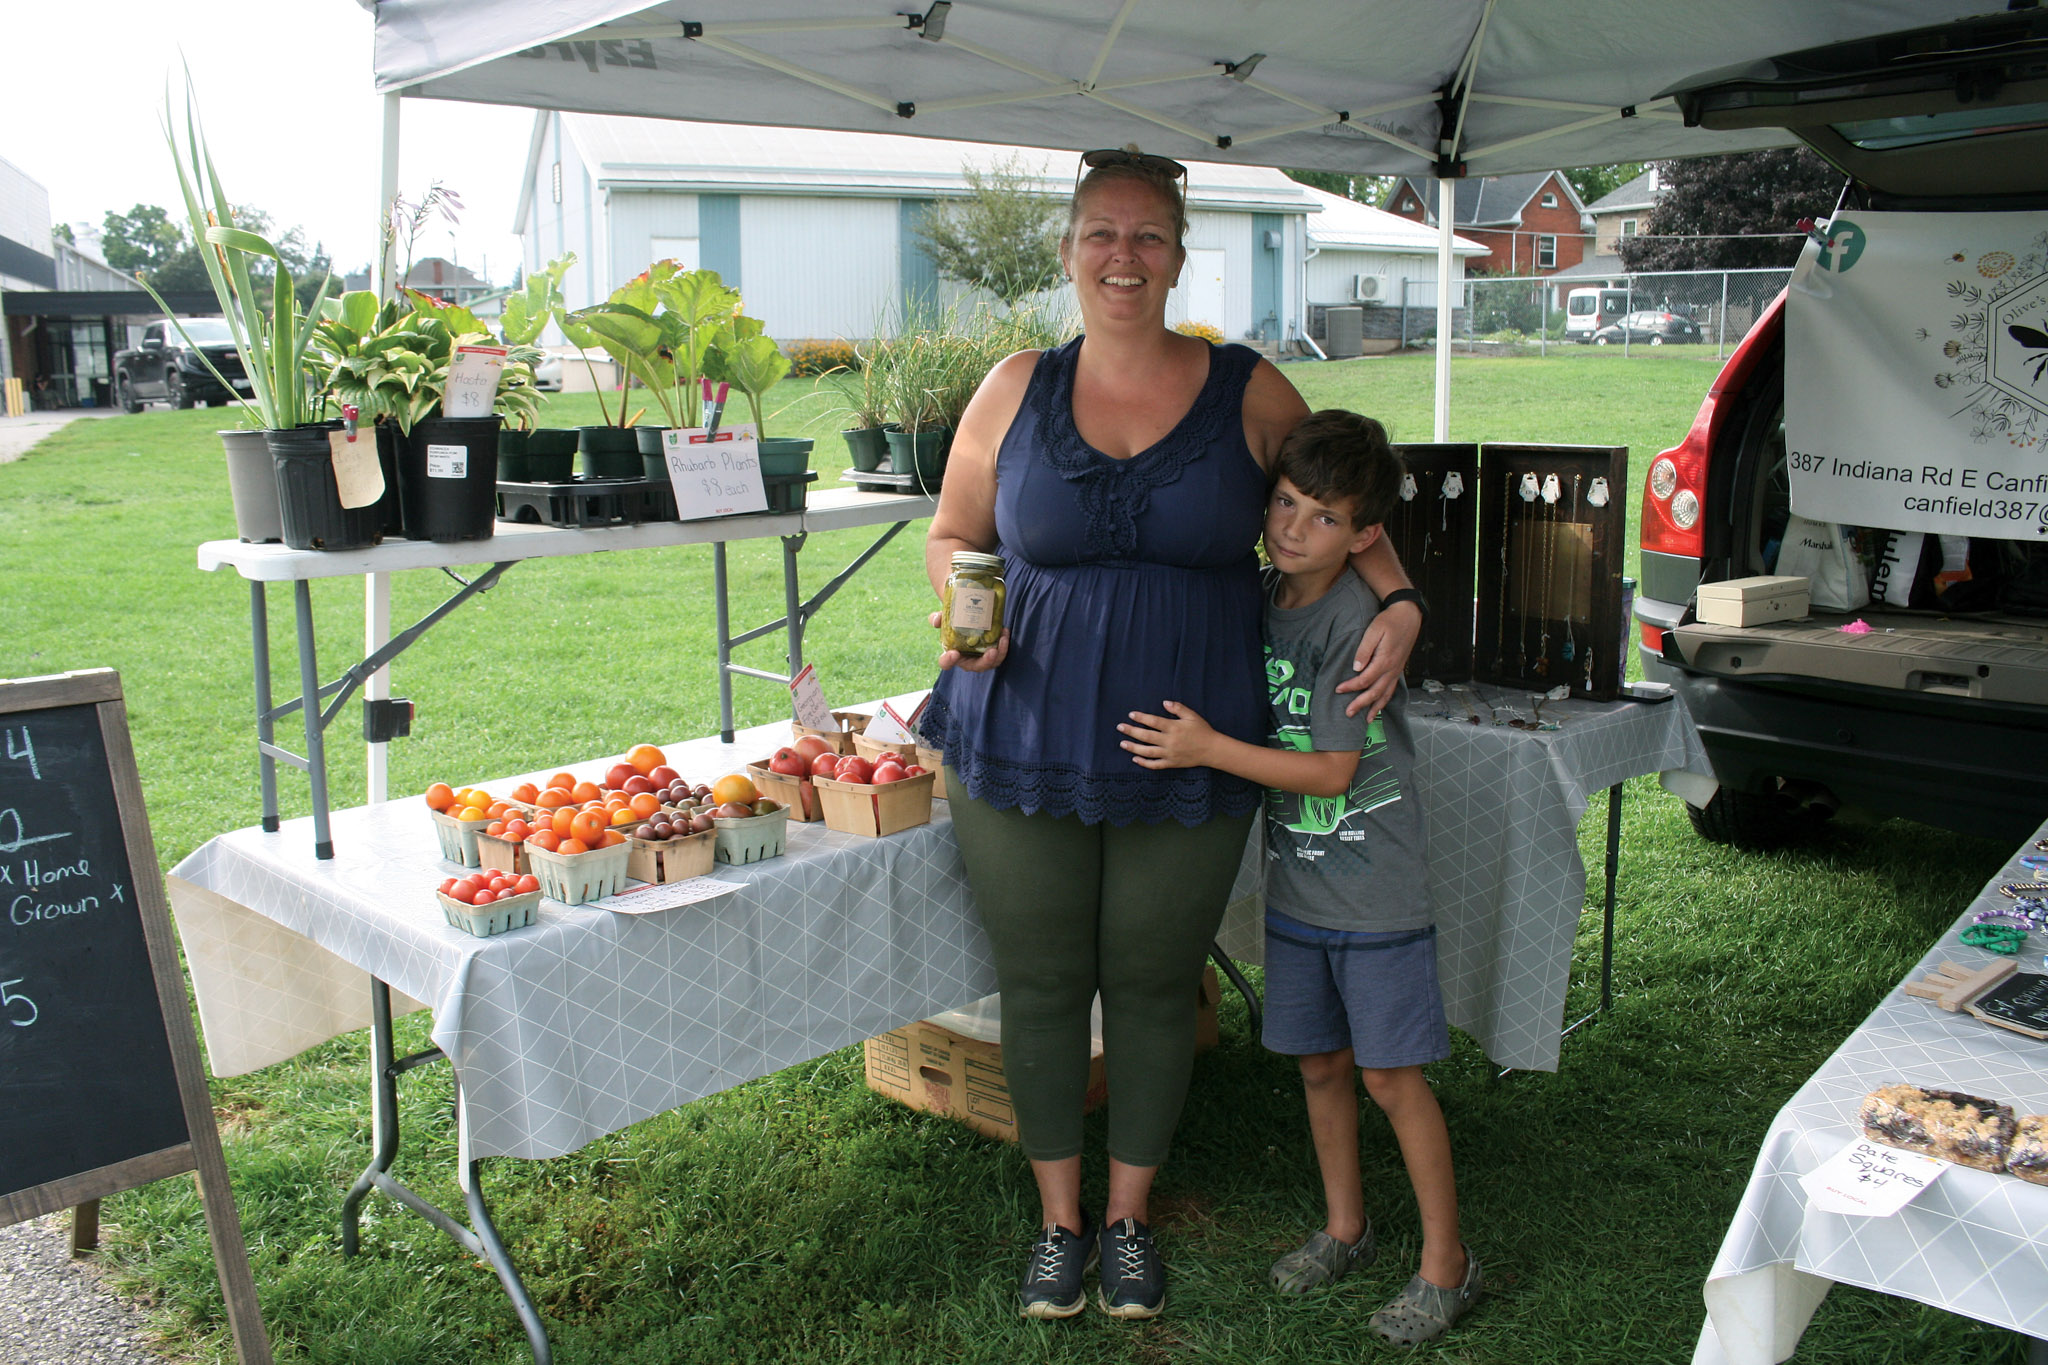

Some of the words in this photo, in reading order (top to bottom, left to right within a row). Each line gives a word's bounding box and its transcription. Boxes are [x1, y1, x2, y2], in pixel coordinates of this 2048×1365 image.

[462, 391, 480, 408] $8
[670, 455, 717, 474] Rhubarb
[720, 451, 758, 471] Plants
[1790, 451, 1825, 473] 387
[1832, 458, 1913, 483] Indiana
[1921, 466, 1953, 486] Rd
[1961, 469, 1978, 489] E
[1986, 471, 2048, 493] Canfi
[701, 477, 723, 497] $8
[725, 482, 749, 496] each
[24, 859, 91, 886] Home
[10, 894, 99, 926] Grown
[0, 976, 38, 1027] 5
[1857, 1143, 1898, 1165] Date
[1848, 1152, 1925, 1188] Squares
[1857, 1174, 1888, 1189] $4
